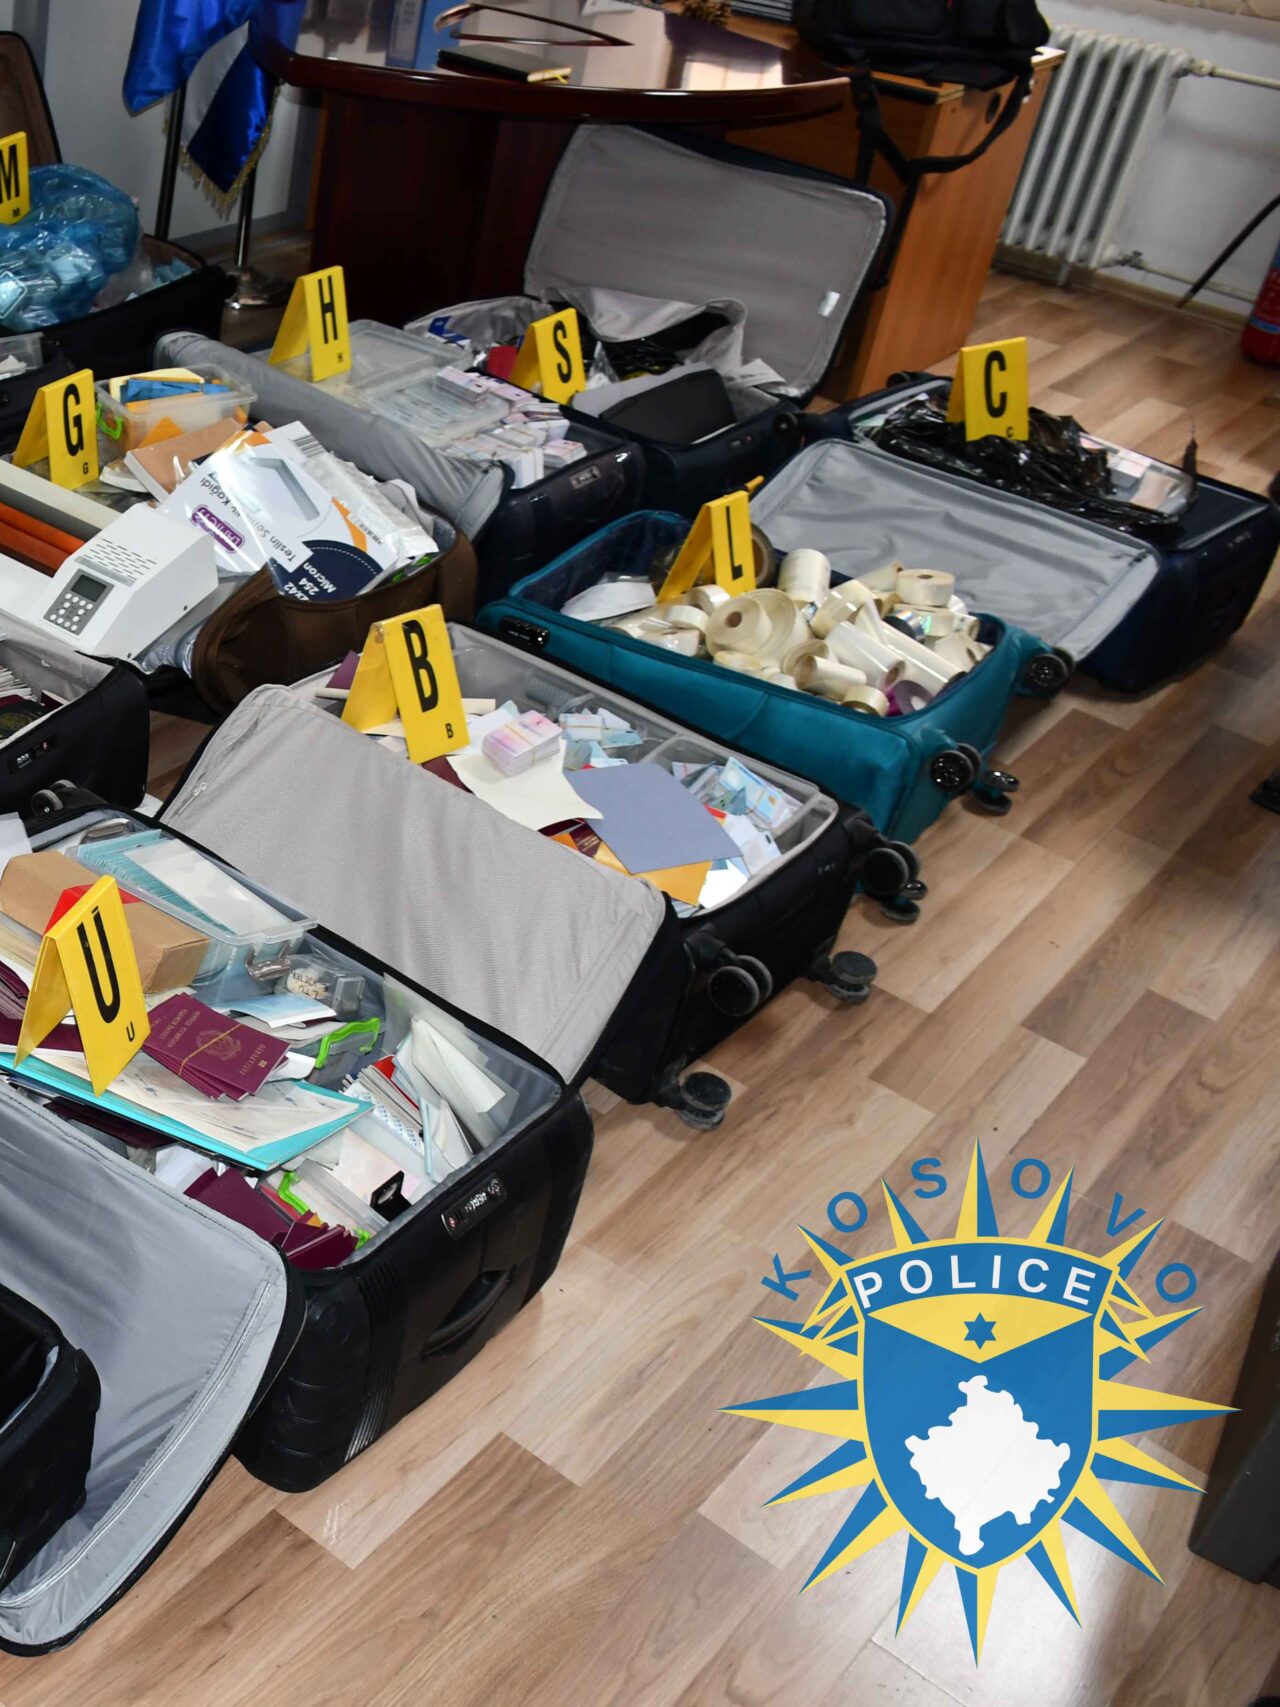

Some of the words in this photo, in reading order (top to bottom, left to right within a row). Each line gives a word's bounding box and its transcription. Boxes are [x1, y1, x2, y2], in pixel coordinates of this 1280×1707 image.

[318, 275, 338, 345] H
[553, 320, 573, 384] S
[983, 349, 1008, 419] C
[63, 383, 85, 457] G
[82, 461, 90, 476] G
[270, 535, 297, 563] Teslin
[725, 505, 744, 582] L
[297, 577, 319, 596] 254
[303, 561, 337, 594] Micron
[403, 619, 439, 713] B
[445, 722, 455, 740] B
[76, 910, 121, 1024] U
[125, 1021, 135, 1043] U
